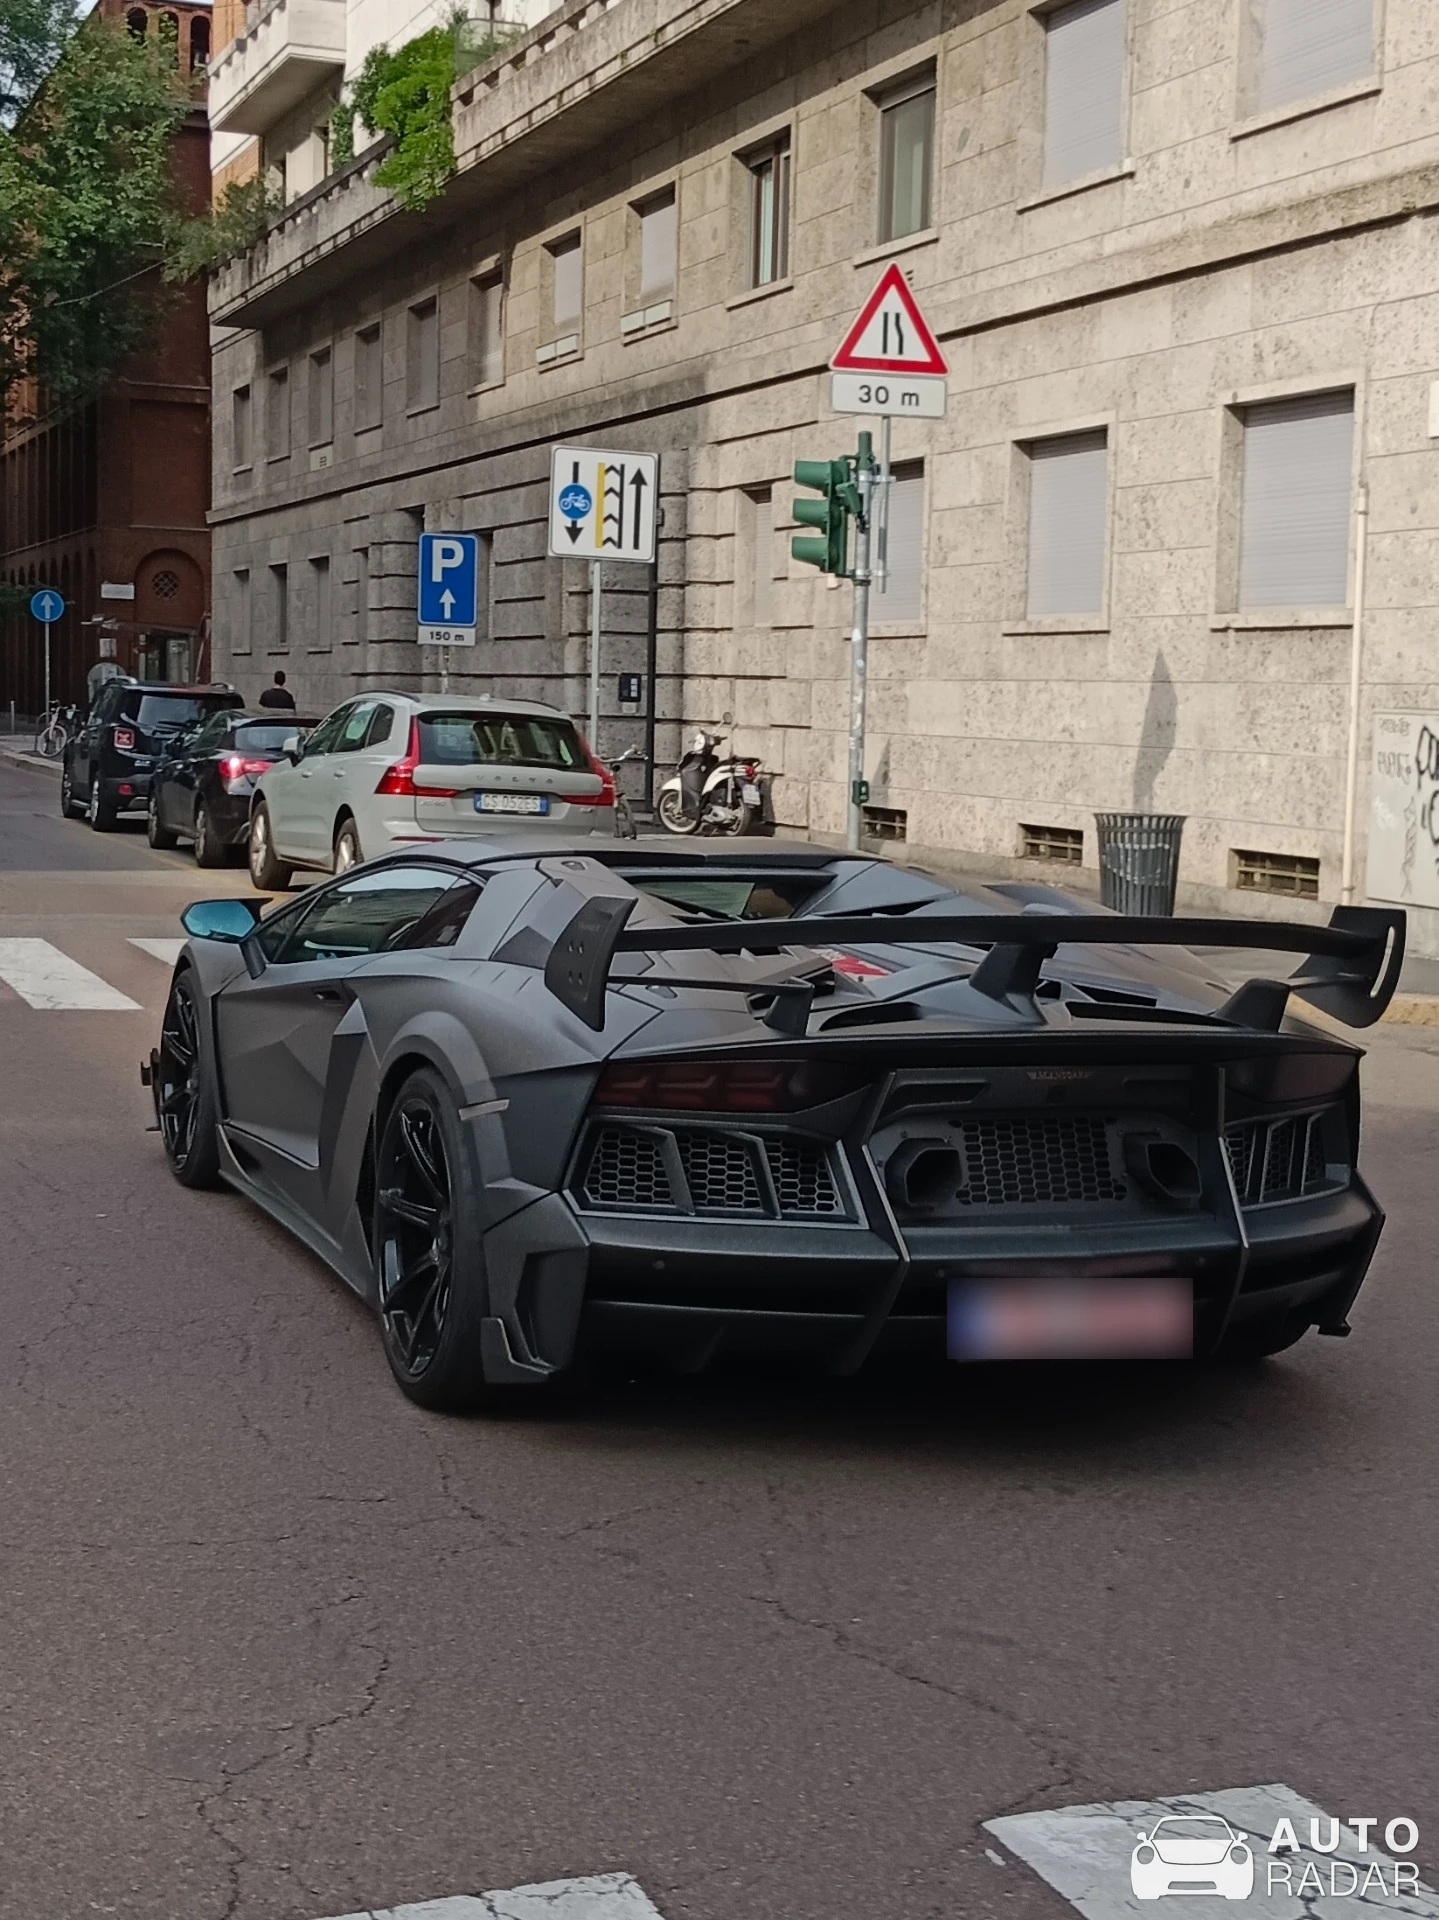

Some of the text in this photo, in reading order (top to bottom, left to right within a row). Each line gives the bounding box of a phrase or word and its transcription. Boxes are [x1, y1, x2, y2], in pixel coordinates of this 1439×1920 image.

[858, 384, 920, 407] 30 m
[432, 539, 465, 583] P
[429, 630, 465, 642] 150 m
